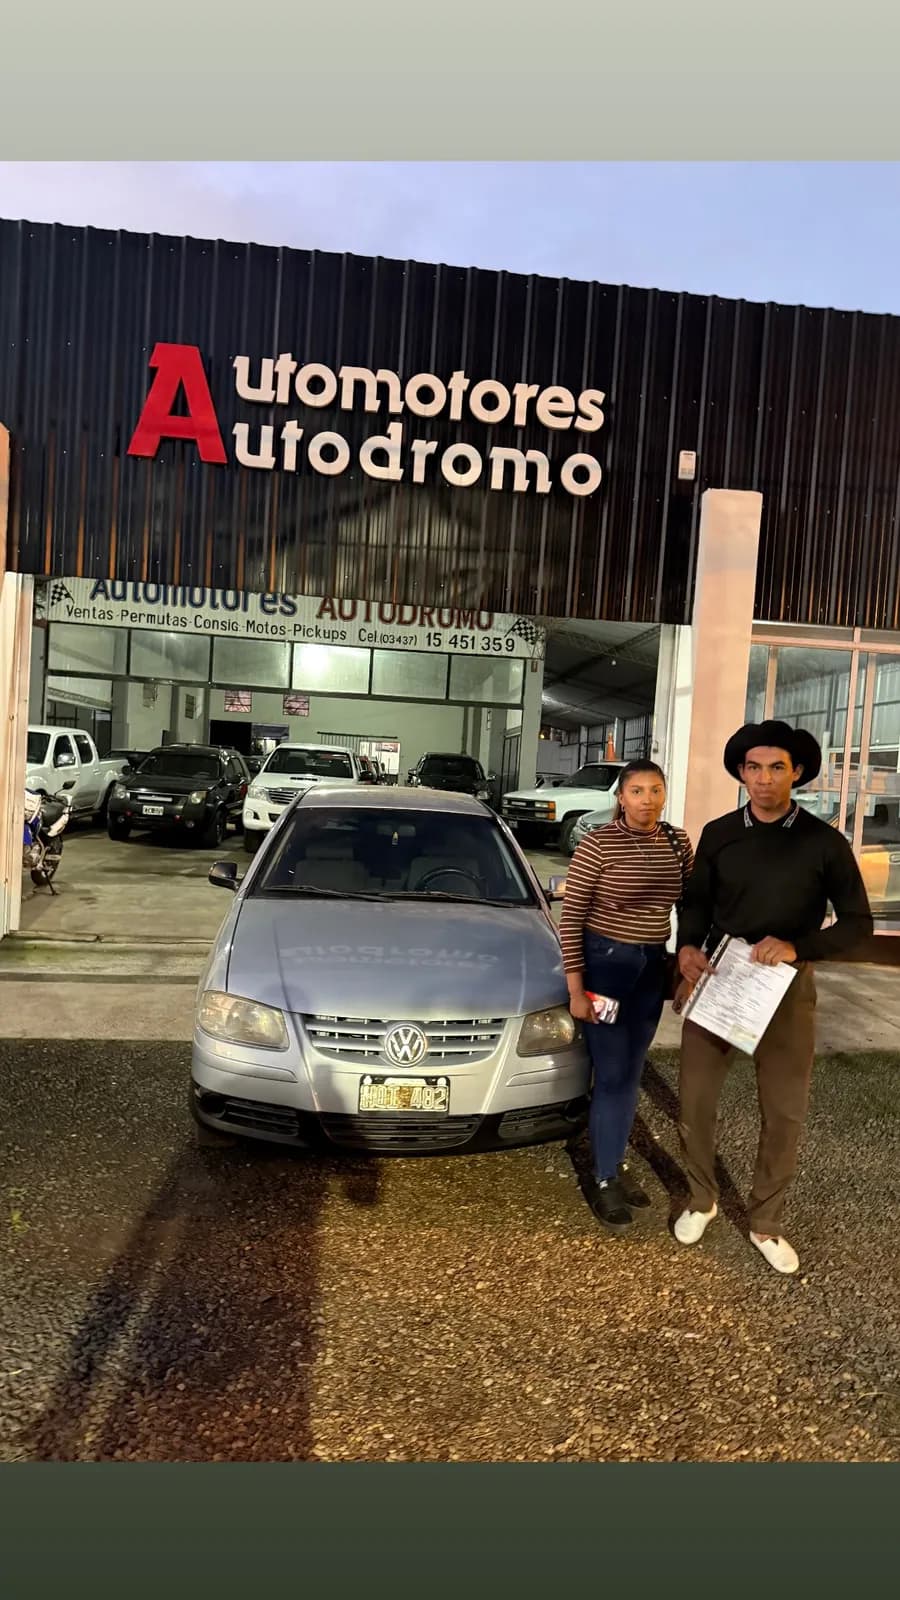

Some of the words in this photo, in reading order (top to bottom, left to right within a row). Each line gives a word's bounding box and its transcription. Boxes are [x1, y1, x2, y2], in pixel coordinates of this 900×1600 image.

[426, 632, 442, 647] 15
[449, 634, 475, 650] 451
[481, 636, 515, 652] 359
[410, 1086, 446, 1110] 482
